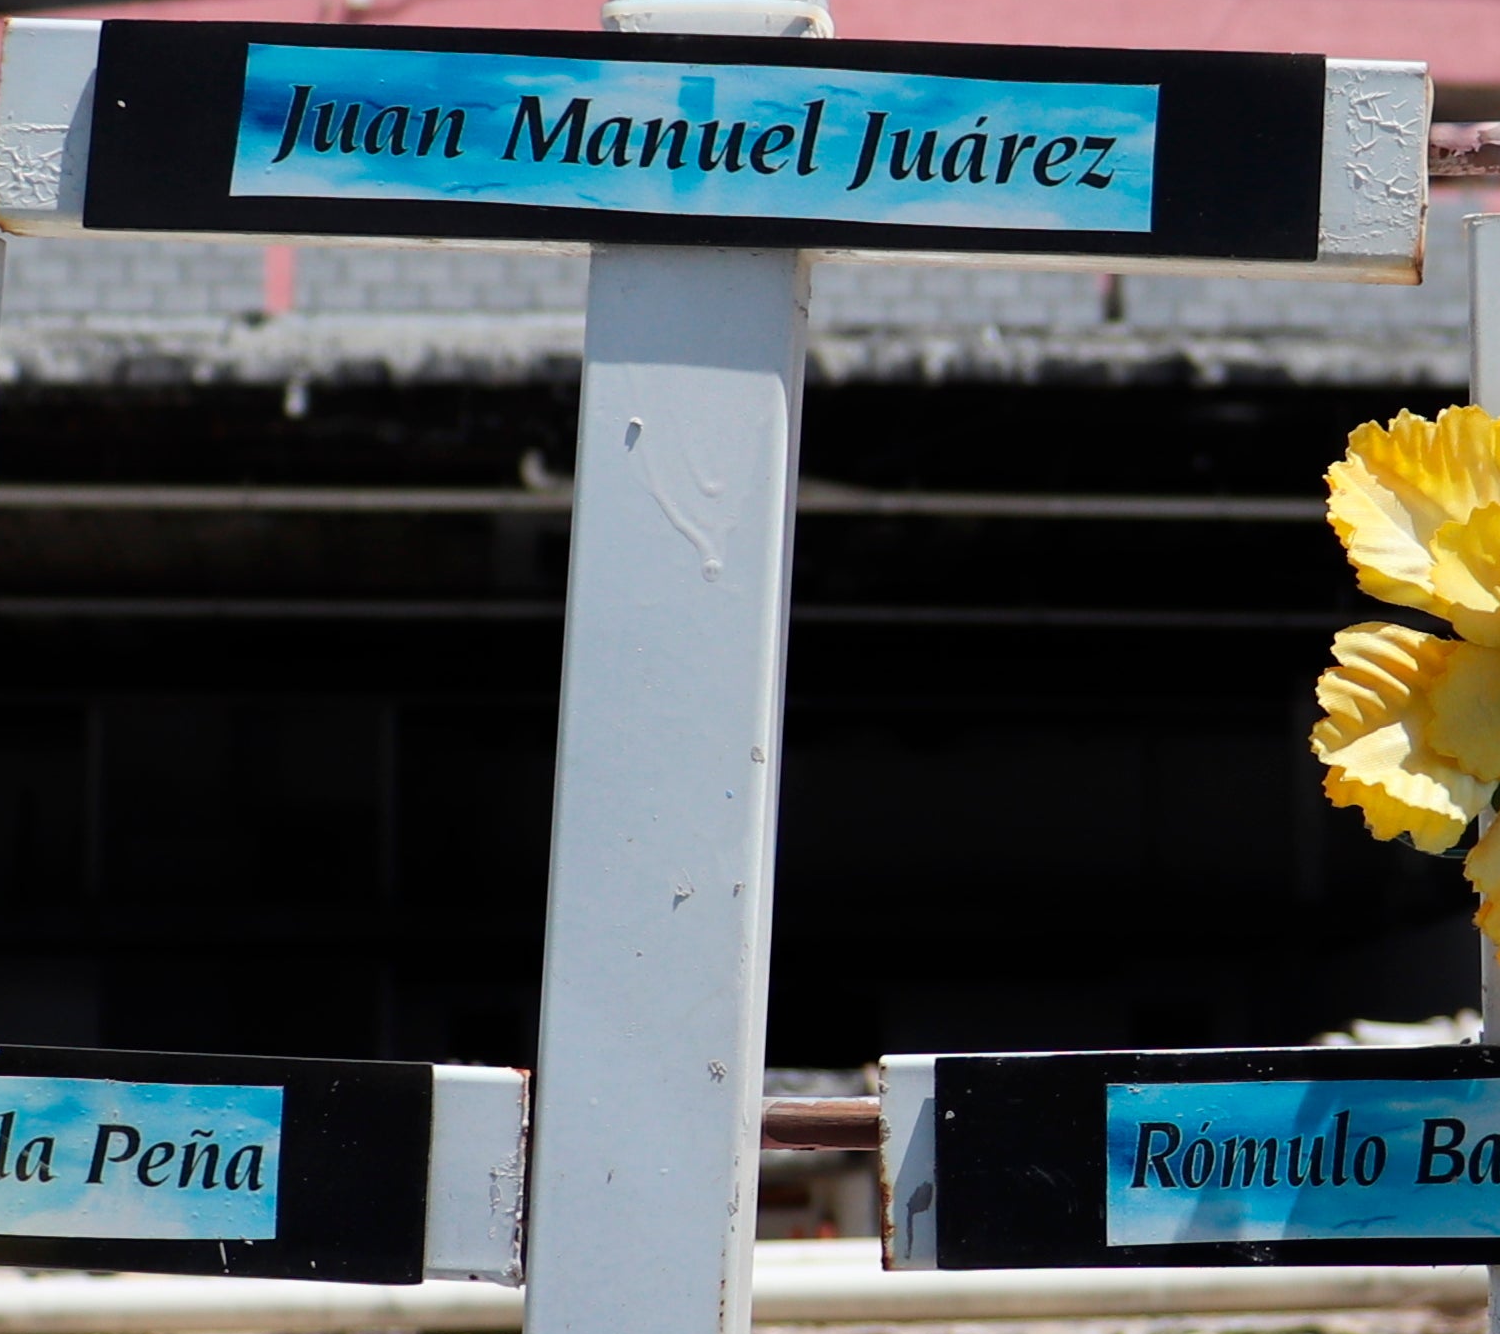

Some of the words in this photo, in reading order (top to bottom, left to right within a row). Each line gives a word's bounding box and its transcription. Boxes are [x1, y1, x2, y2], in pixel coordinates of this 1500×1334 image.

[272, 84, 466, 165] Juan
[502, 94, 820, 177] Manuel
[845, 110, 1117, 191] Juárez
[85, 1124, 265, 1191] Peña
[1129, 1109, 1386, 1190] Rómulo
